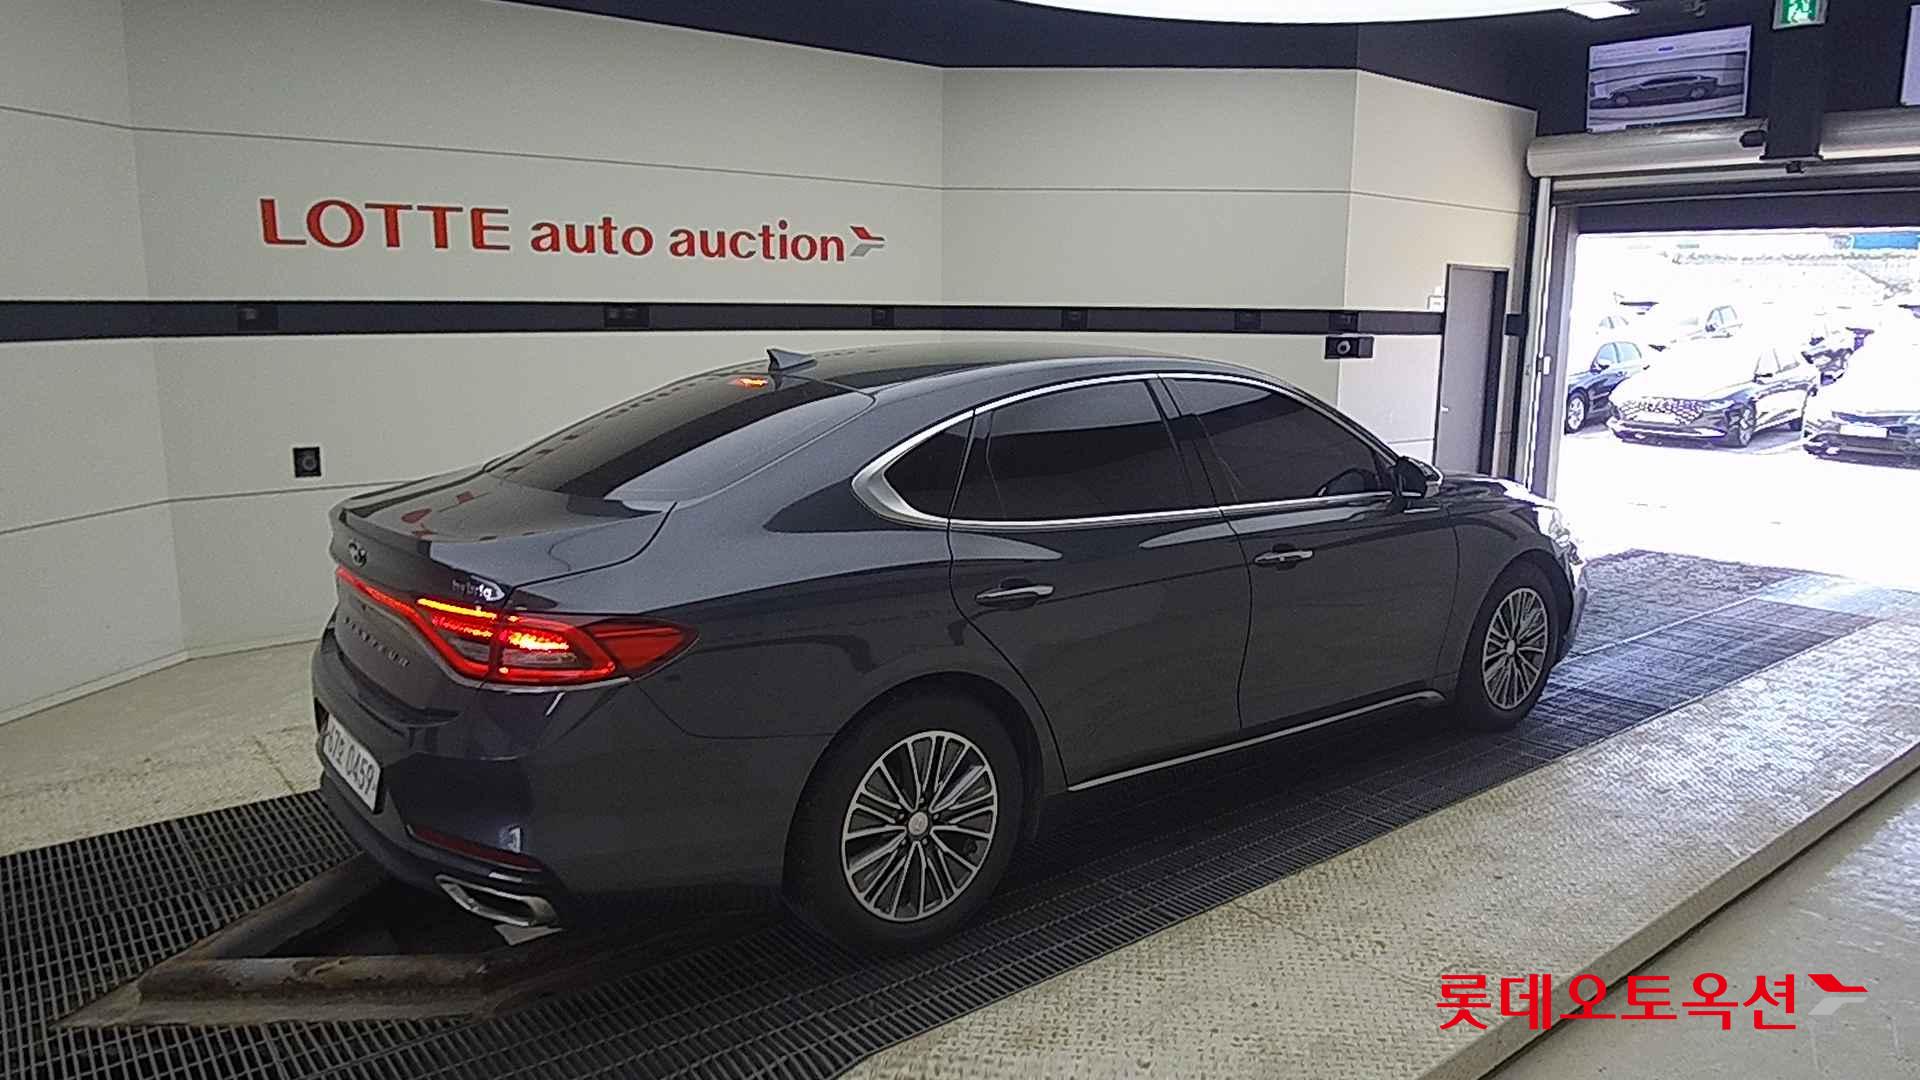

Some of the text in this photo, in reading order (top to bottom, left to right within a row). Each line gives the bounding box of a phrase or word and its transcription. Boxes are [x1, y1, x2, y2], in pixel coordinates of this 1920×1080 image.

[259, 198, 846, 261] LOTTE auto auction
